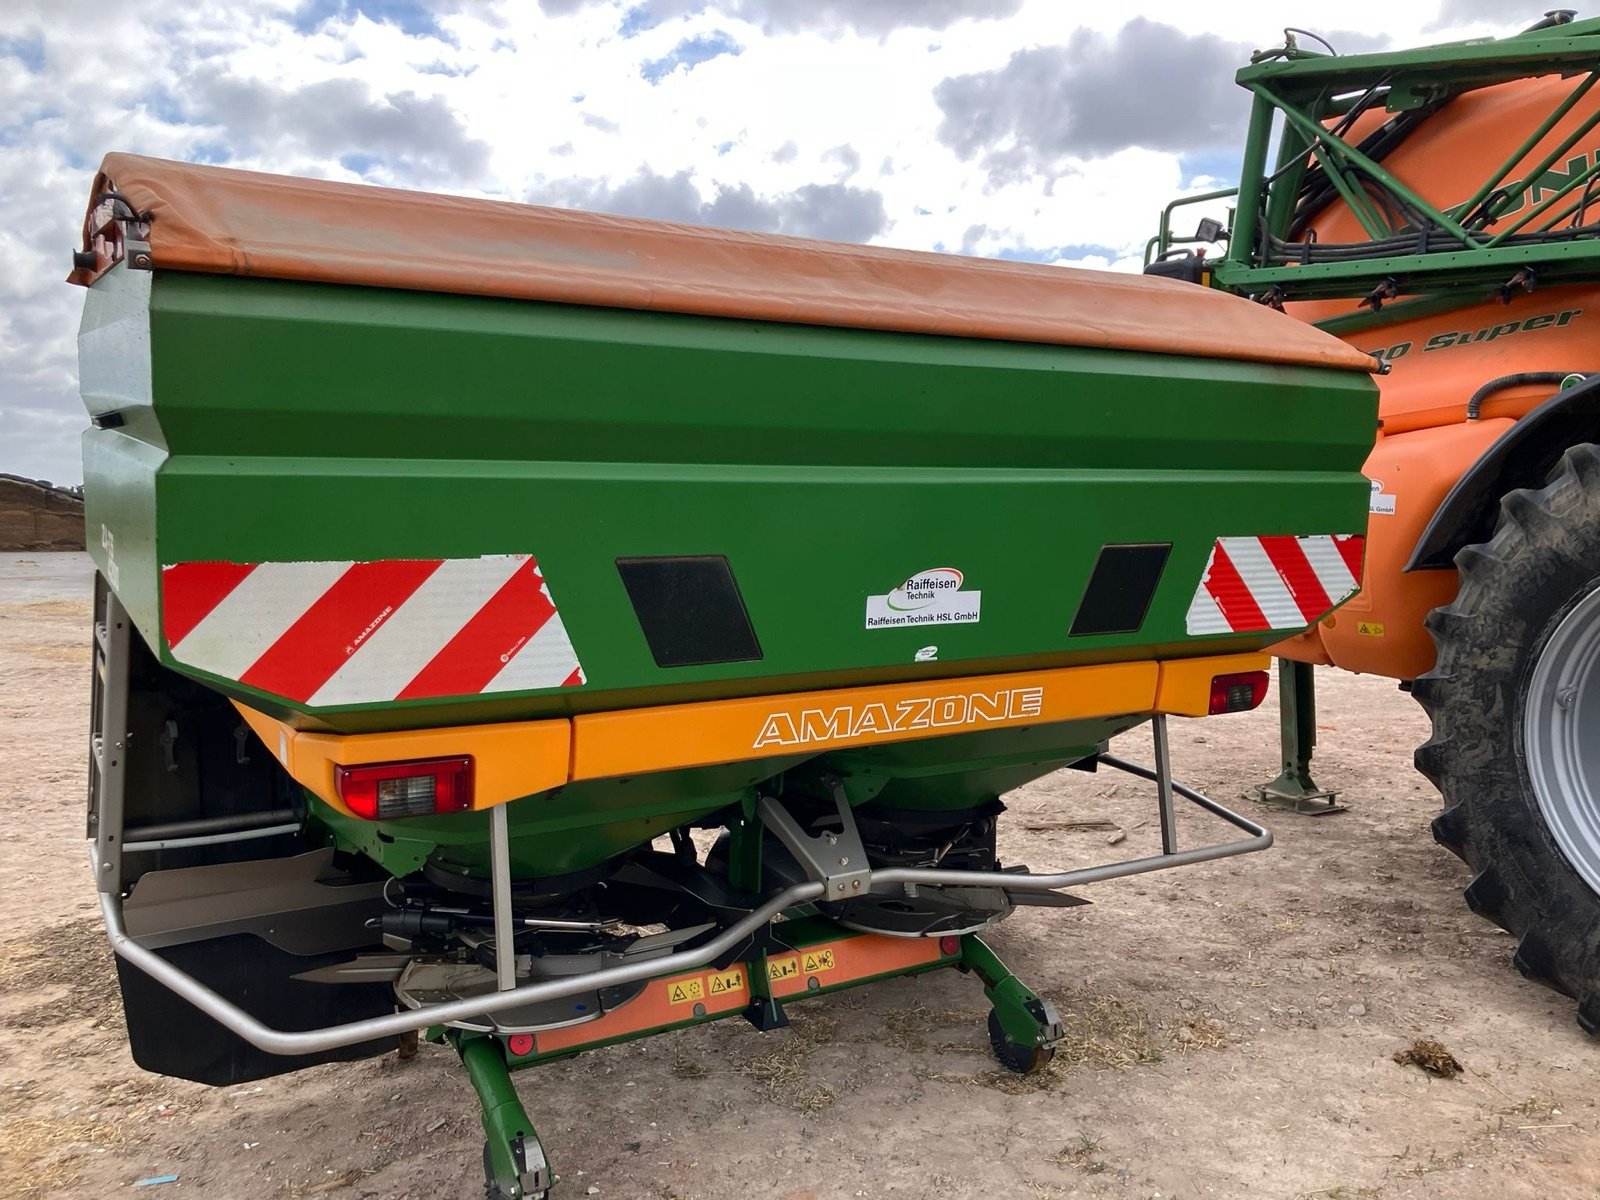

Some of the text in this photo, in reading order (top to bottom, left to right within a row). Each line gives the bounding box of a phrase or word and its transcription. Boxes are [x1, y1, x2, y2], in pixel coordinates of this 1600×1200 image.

[1423, 309, 1583, 352] Super
[906, 578, 957, 591] Raiffeisen
[906, 591, 935, 600] Technik
[353, 606, 393, 646] AMAZONE
[867, 611, 978, 626] Raiffeisen Technik HSL GmbH
[753, 687, 1043, 748] AMAZONE
